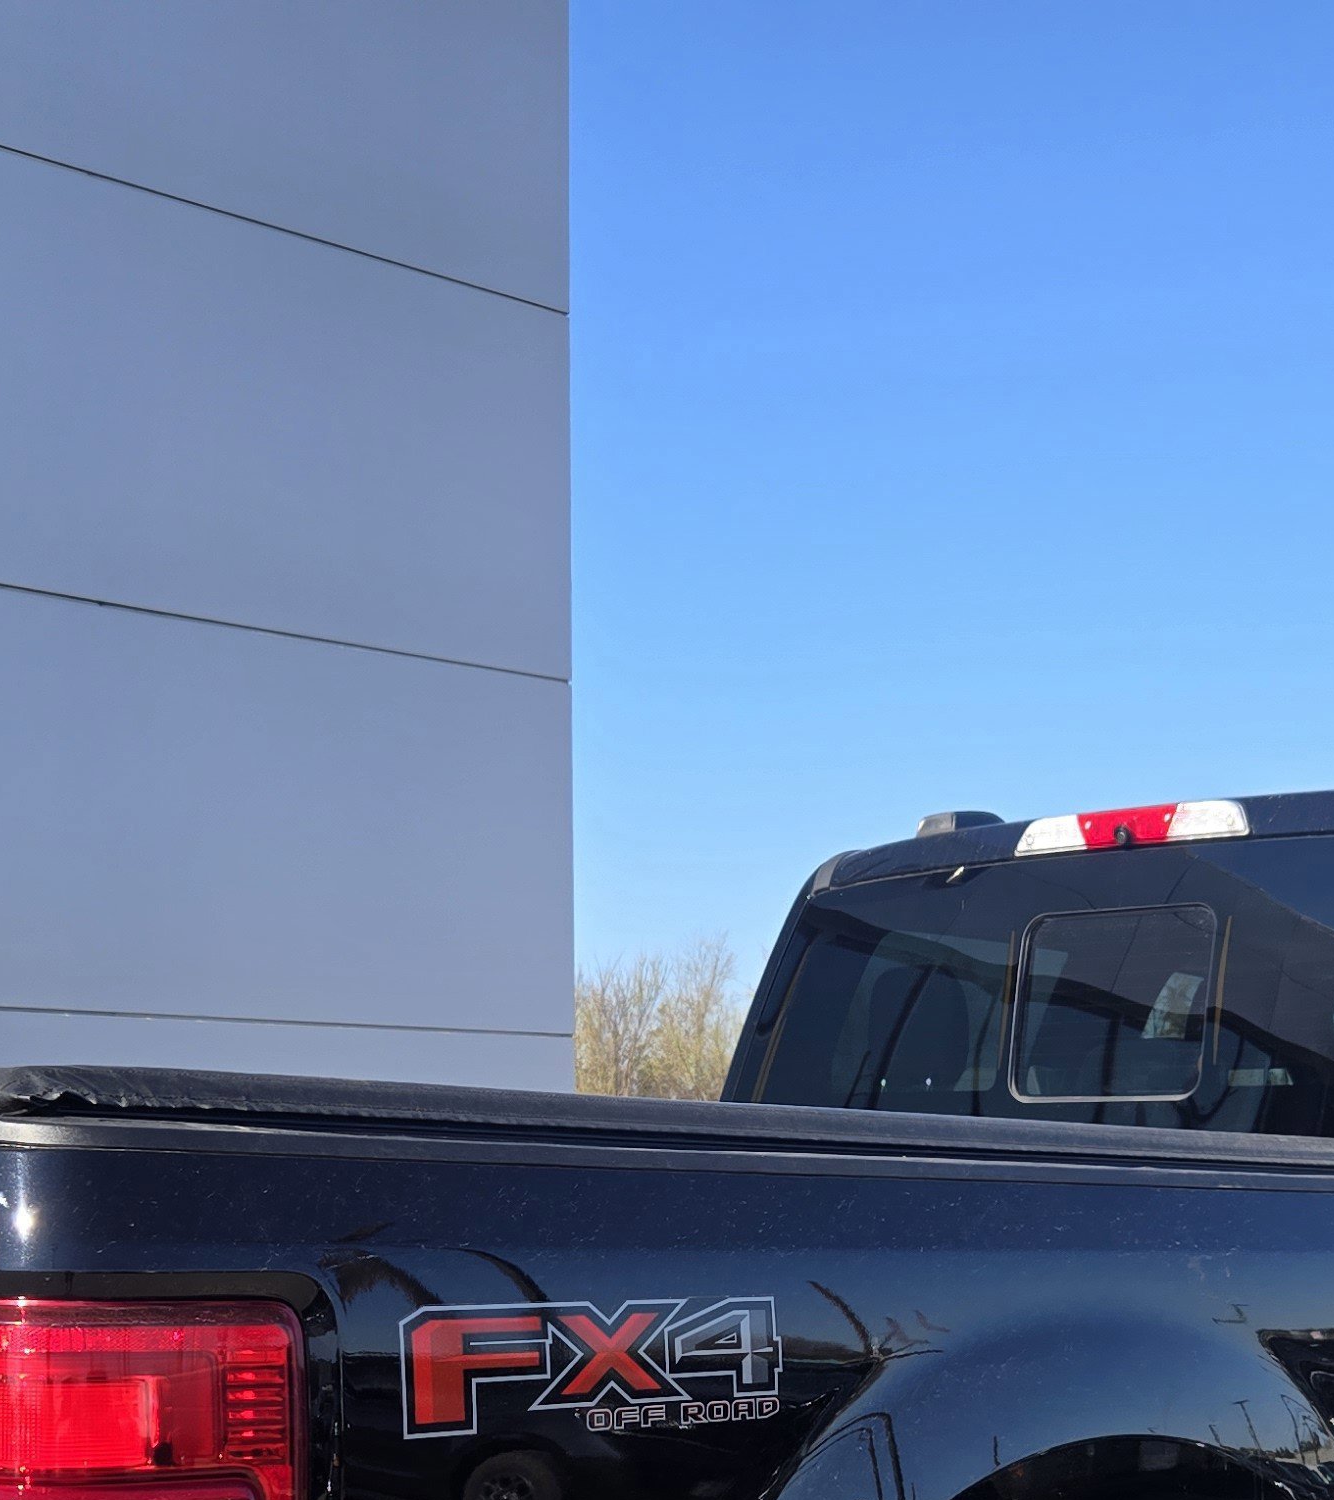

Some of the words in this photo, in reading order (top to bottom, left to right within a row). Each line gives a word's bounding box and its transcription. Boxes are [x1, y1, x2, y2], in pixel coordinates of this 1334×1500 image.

[400, 1297, 782, 1439] FX4
[586, 1403, 666, 1432] OFF
[680, 1397, 779, 1427] ROAD
